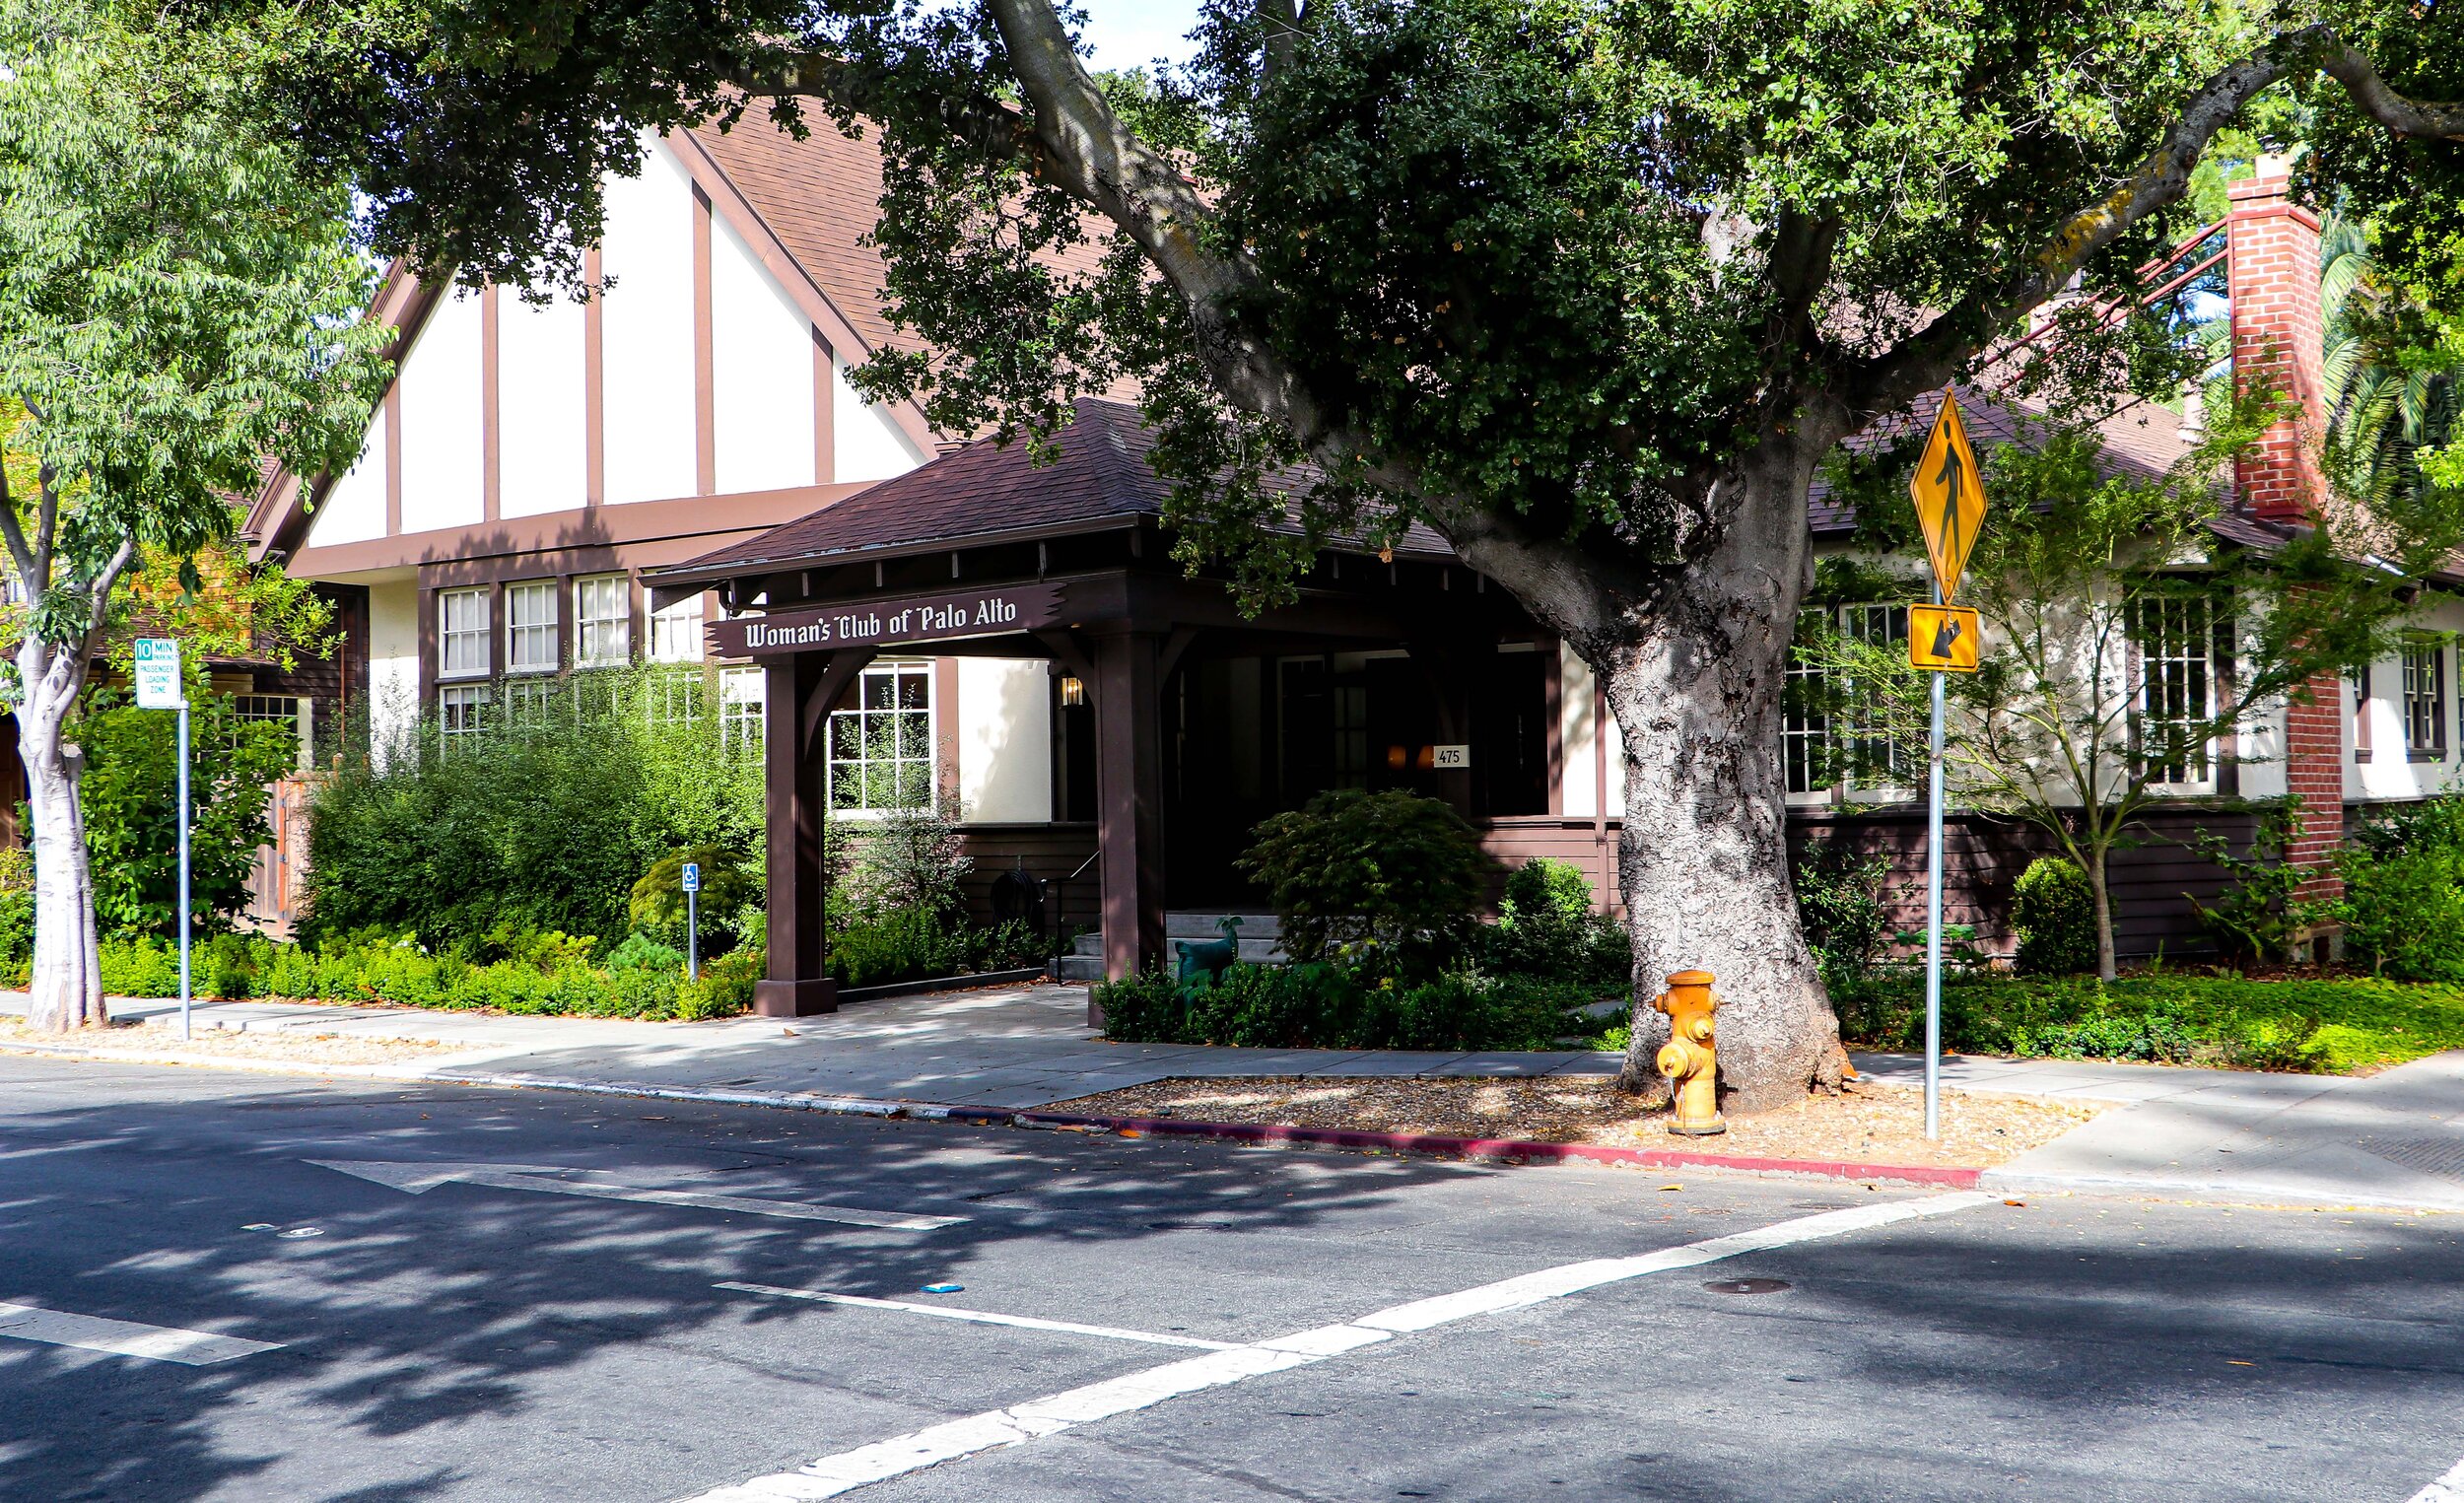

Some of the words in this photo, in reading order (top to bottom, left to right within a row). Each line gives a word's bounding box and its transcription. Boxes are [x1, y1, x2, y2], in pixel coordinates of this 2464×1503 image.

[745, 617, 831, 649] Woman's
[833, 614, 880, 639] Club
[889, 608, 913, 634] of
[916, 602, 967, 630] Palo
[973, 597, 1017, 626] Alto
[137, 643, 151, 657] 10
[155, 643, 172, 652] MIN
[1439, 750, 1460, 763] 475
